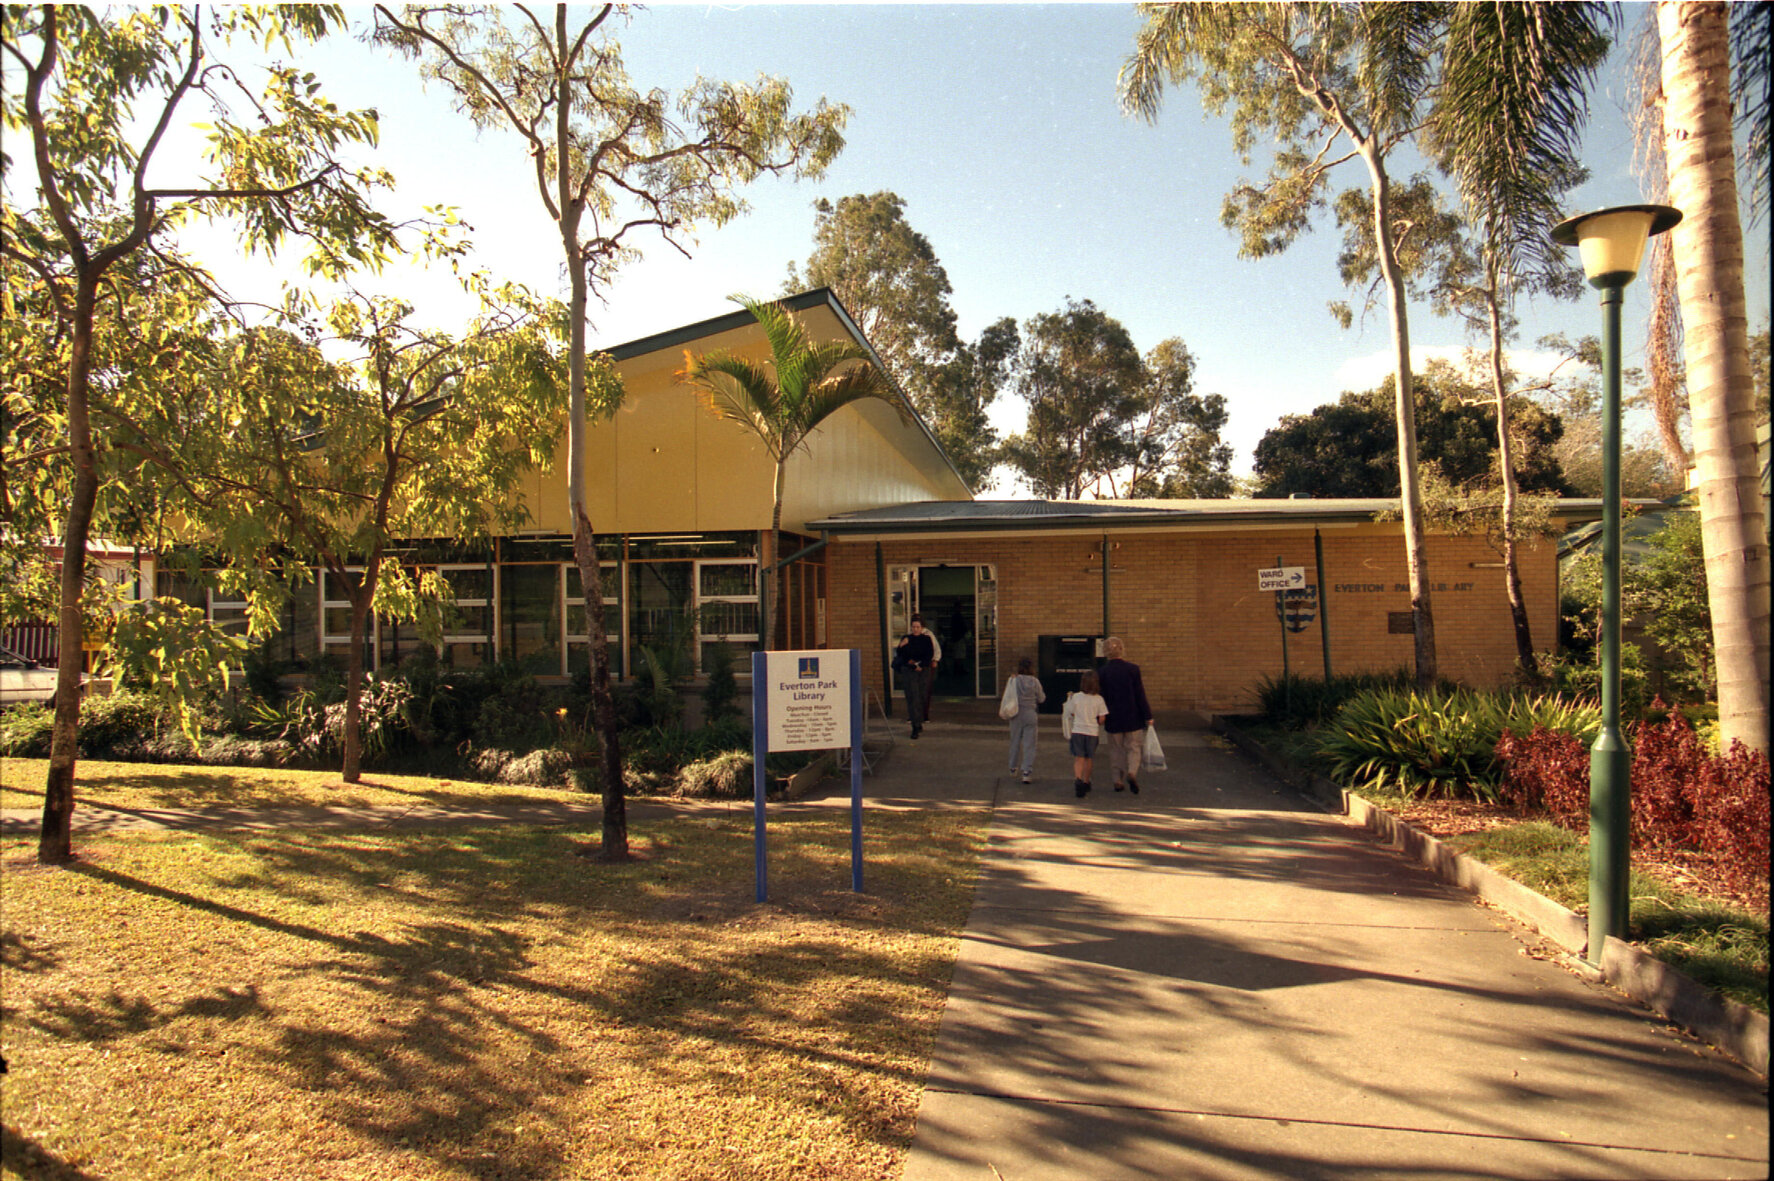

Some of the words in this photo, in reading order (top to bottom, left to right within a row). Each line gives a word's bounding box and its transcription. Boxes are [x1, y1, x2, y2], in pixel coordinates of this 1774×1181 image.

[1260, 570, 1284, 578] WARD
[1260, 579, 1290, 588] OFFICE
[1334, 583, 1384, 592] EVERTON
[779, 682, 815, 691] Everton
[817, 680, 838, 689] Park
[793, 691, 825, 701] Library
